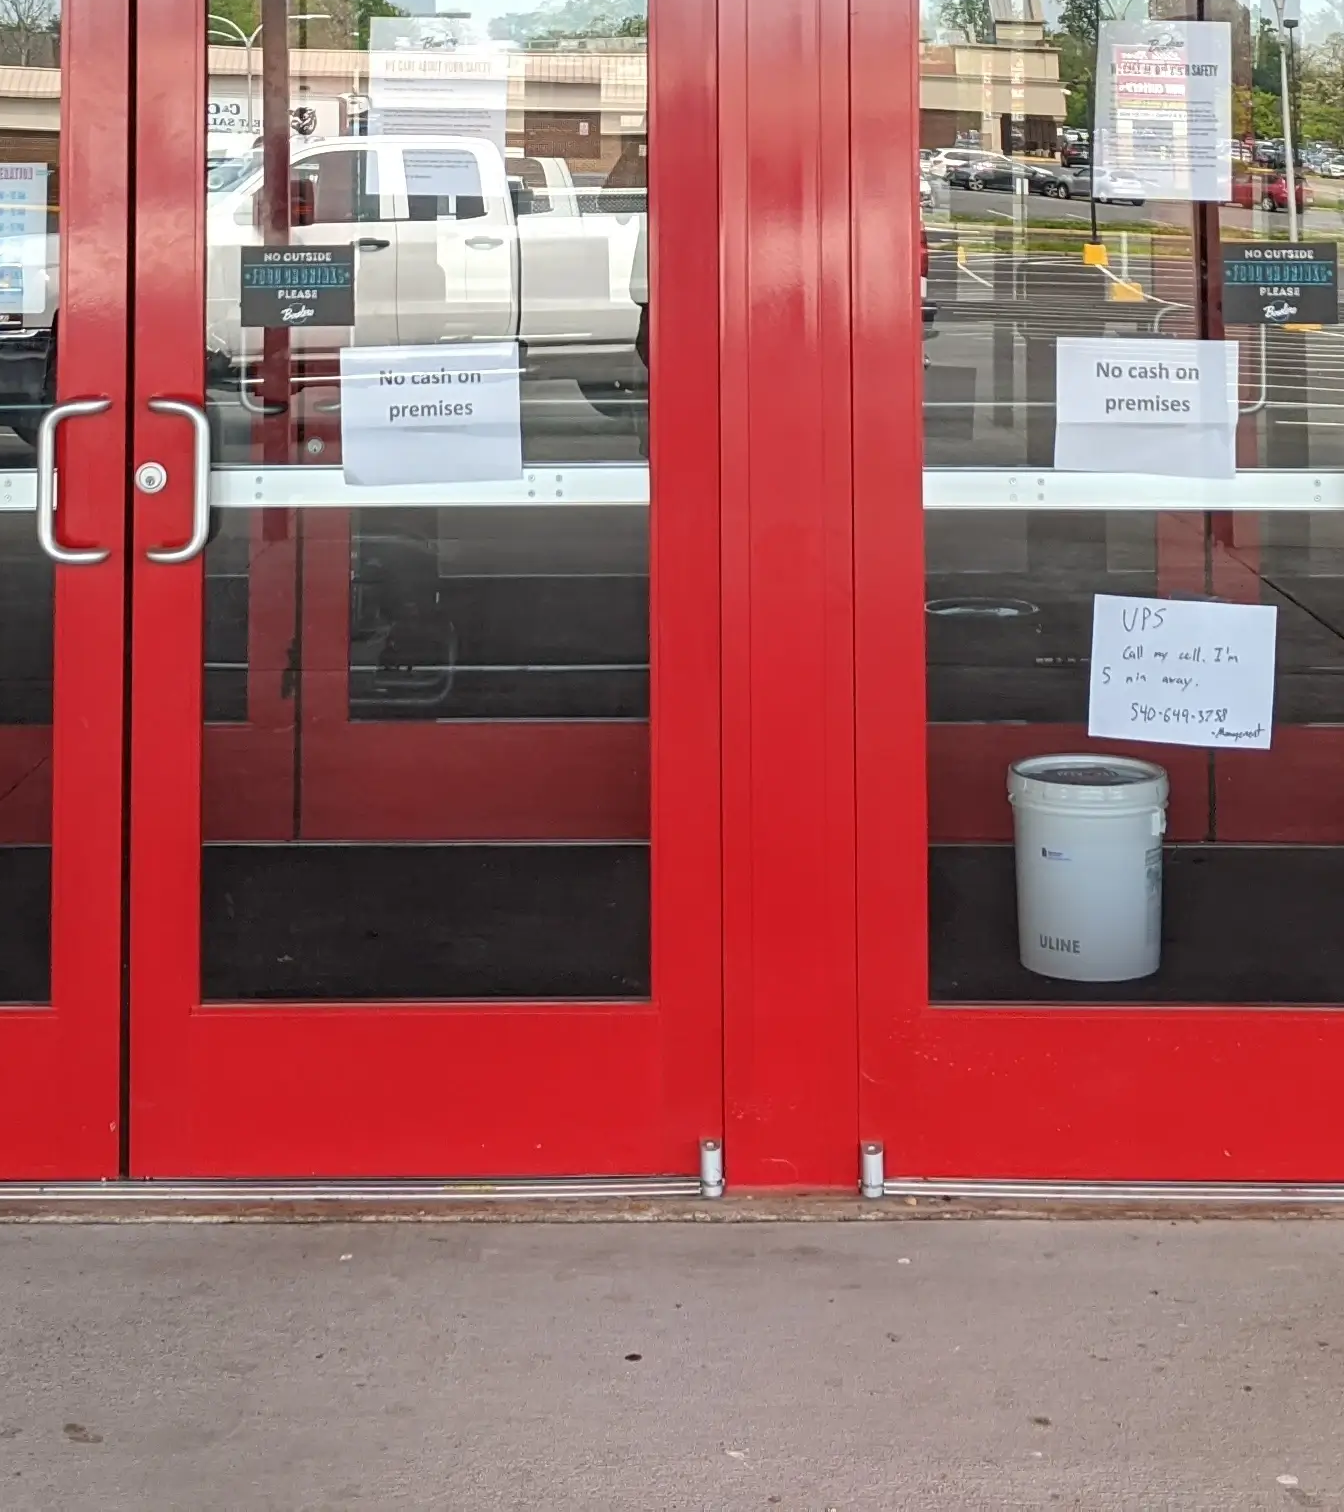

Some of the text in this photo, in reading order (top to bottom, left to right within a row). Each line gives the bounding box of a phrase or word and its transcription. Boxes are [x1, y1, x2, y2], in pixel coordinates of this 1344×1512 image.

[1191, 64, 1218, 77] SAFETY
[264, 252, 333, 262] NO OUTSIDE
[1244, 249, 1314, 259] NO OUTSIDE
[277, 289, 318, 299] PLEASE
[1259, 287, 1300, 296] PLEASE
[379, 368, 481, 386] No cash on
[1096, 362, 1199, 380] No cash on
[389, 400, 473, 422] premises
[1105, 395, 1191, 414] premises
[1122, 607, 1167, 632] UPS
[1122, 644, 1143, 660] Call
[1154, 651, 1169, 663] my
[1214, 646, 1239, 663] I'm
[1102, 666, 1112, 684] 5
[1162, 676, 1199, 691] away.
[1039, 934, 1081, 954] ULINE
